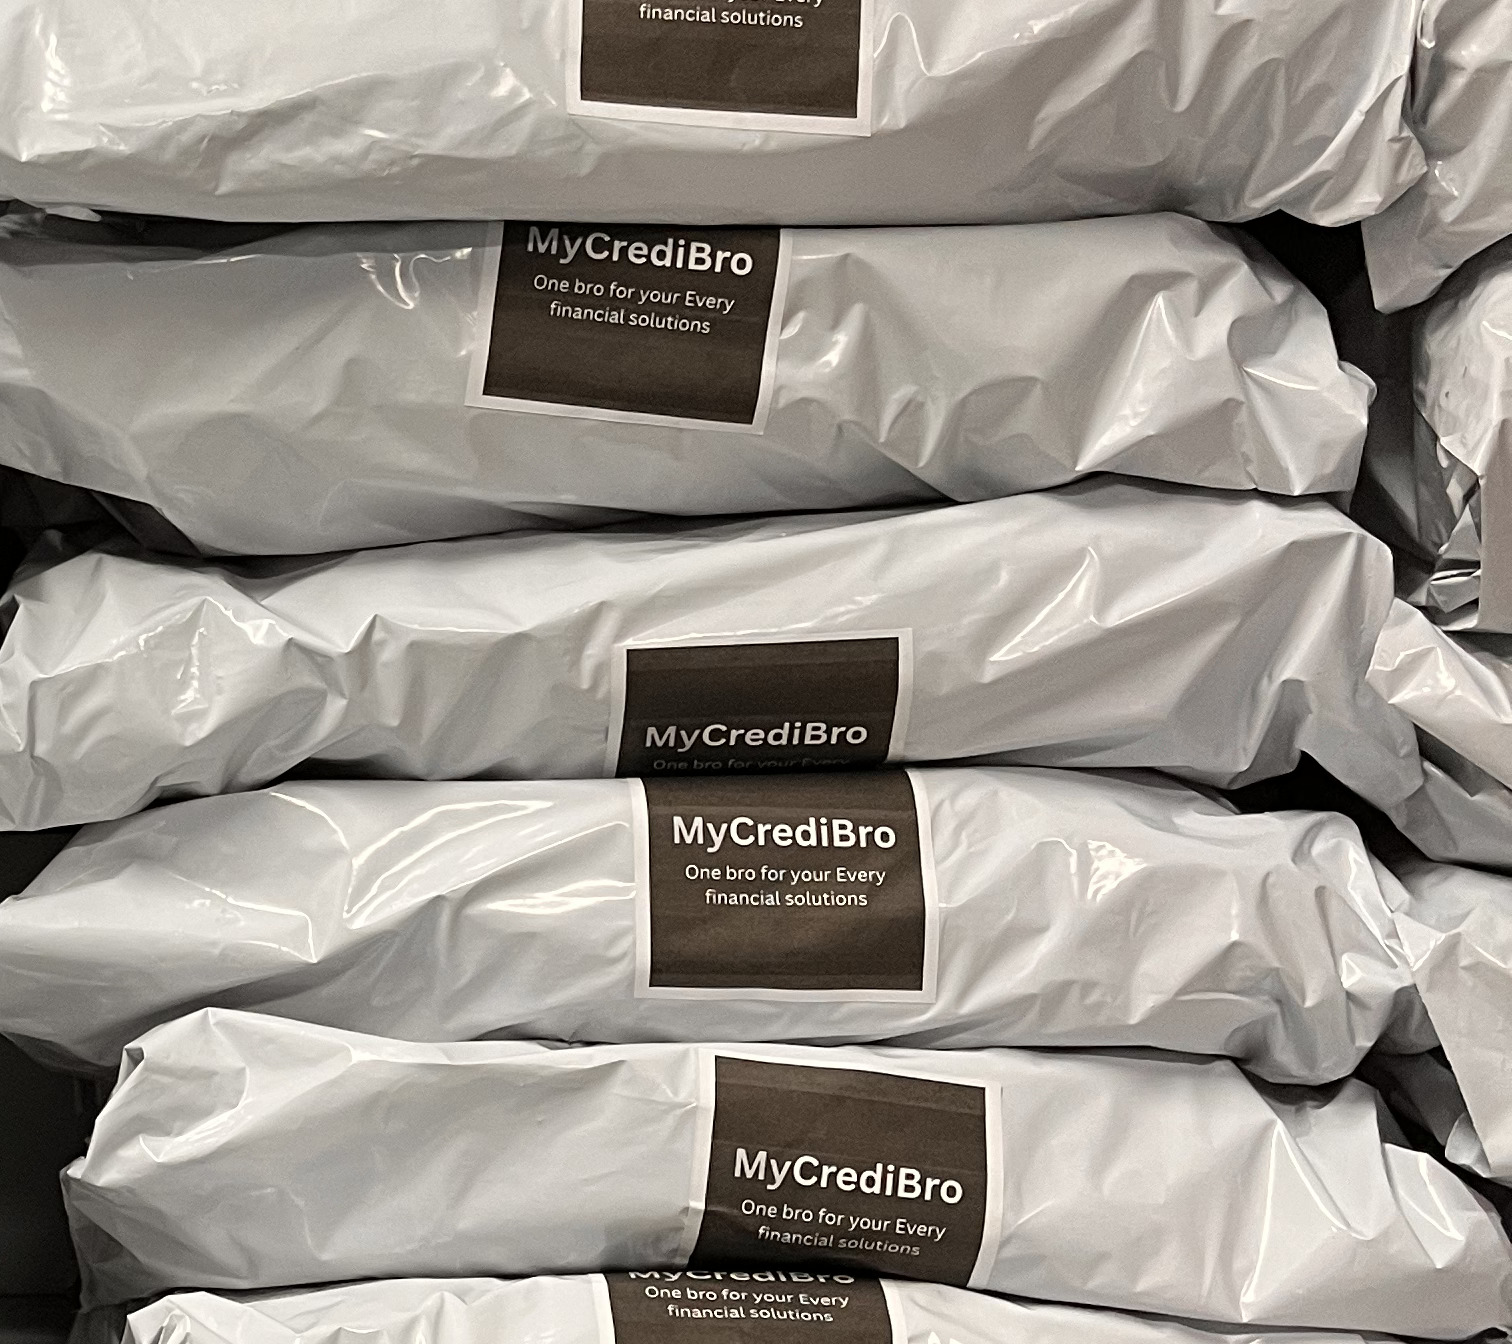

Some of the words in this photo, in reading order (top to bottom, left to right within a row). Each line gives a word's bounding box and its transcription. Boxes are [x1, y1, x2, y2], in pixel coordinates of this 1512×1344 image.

[638, 3, 717, 23] financial
[719, 8, 804, 29] solutions
[526, 225, 754, 276] MyCrediBro
[532, 274, 571, 293] One
[573, 278, 605, 297] bro
[608, 281, 636, 300] for
[637, 286, 682, 306] your
[684, 290, 736, 315] Every
[549, 300, 625, 325] financial
[628, 310, 712, 335] solutions
[644, 721, 869, 754] MyCrediBro
[671, 815, 897, 854] MyCrediBro
[684, 863, 722, 881] One
[725, 864, 757, 882] bro
[760, 864, 789, 882] for
[789, 868, 833, 886] your
[835, 866, 886, 887] Every
[704, 888, 781, 907] financial
[784, 891, 869, 907] solutions
[733, 1147, 964, 1205] MyCrediBro
[740, 1198, 778, 1218] One
[781, 1203, 814, 1224] bro
[817, 1207, 846, 1227] for
[847, 1214, 892, 1233] your
[894, 1217, 947, 1243] Every
[757, 1225, 834, 1248] financial
[837, 1235, 921, 1257] solutions
[644, 1285, 683, 1301] One
[686, 1286, 718, 1301] bro
[721, 1287, 751, 1302] for
[751, 1291, 795, 1305] your
[798, 1293, 850, 1309] Every
[666, 1303, 747, 1321] financial
[749, 1306, 835, 1323] solutions
